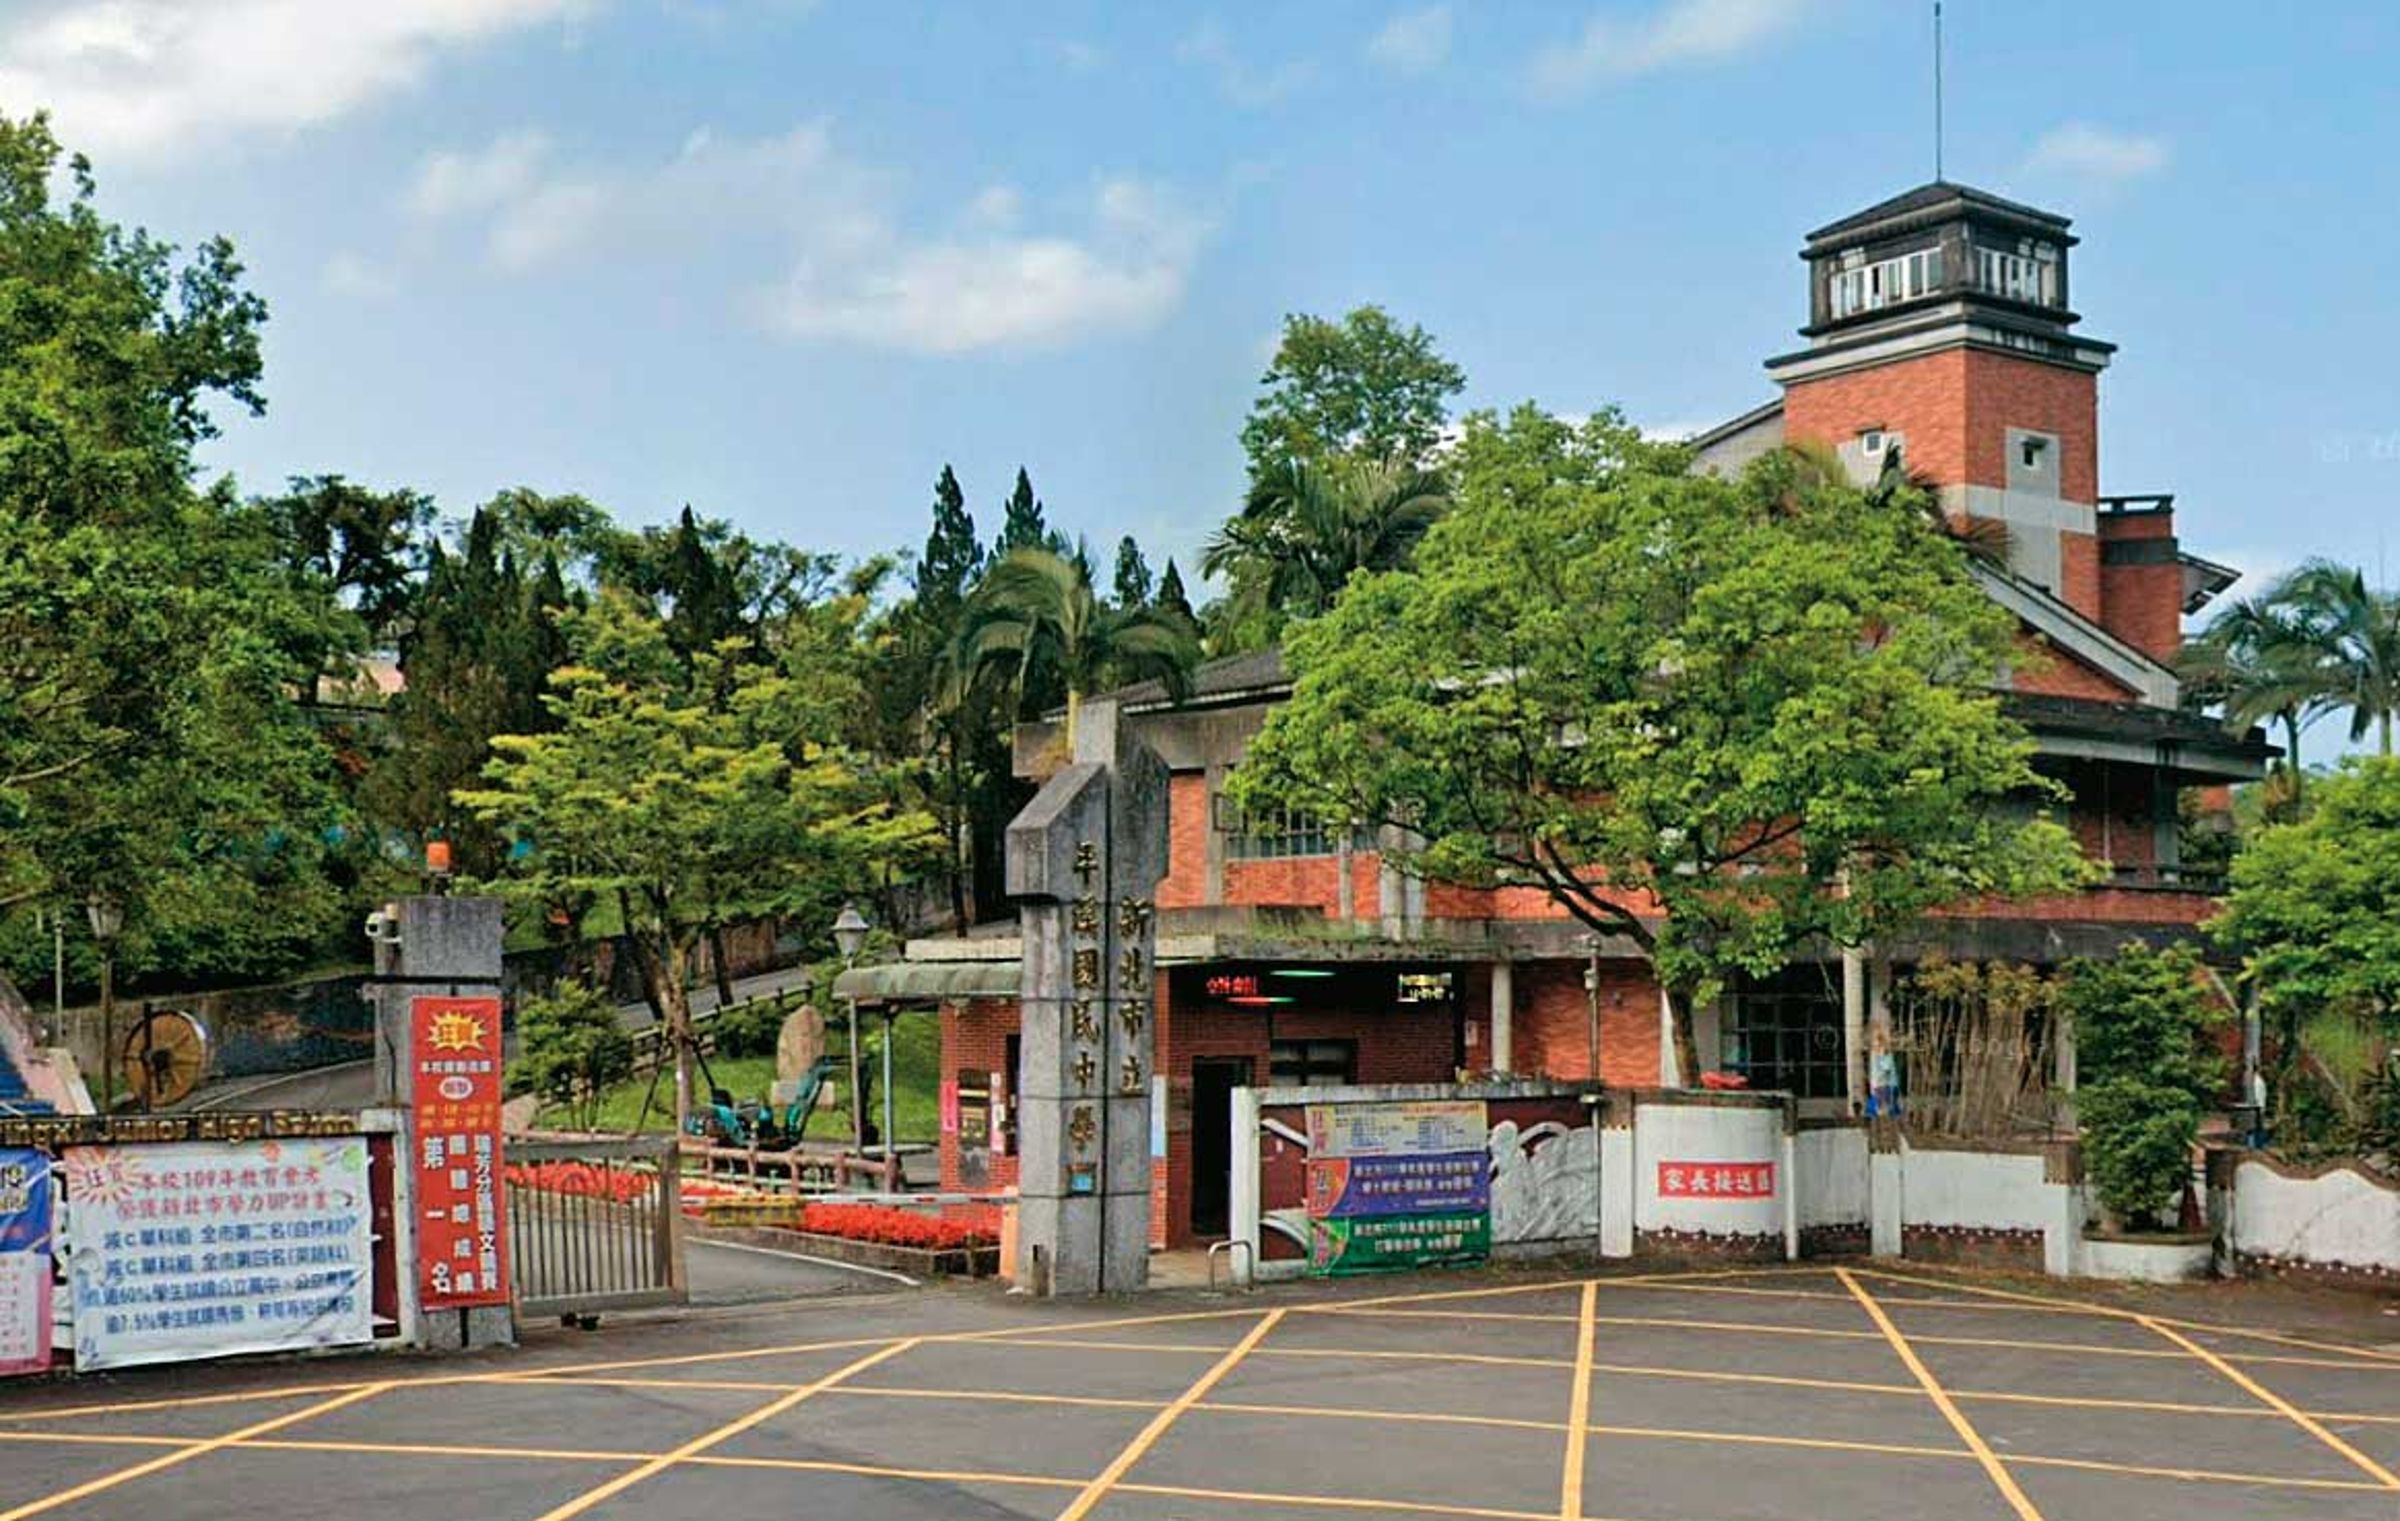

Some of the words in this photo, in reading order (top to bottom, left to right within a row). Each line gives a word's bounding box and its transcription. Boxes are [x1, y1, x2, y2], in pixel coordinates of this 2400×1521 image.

[1071, 841, 1099, 1151] 平溪國民中學
[1119, 897, 1151, 1095] 新北市立
[98, 1115, 188, 1141] Junior
[1665, 1168, 1770, 1192] 家長接送區
[423, 1137, 451, 1293] 第一名
